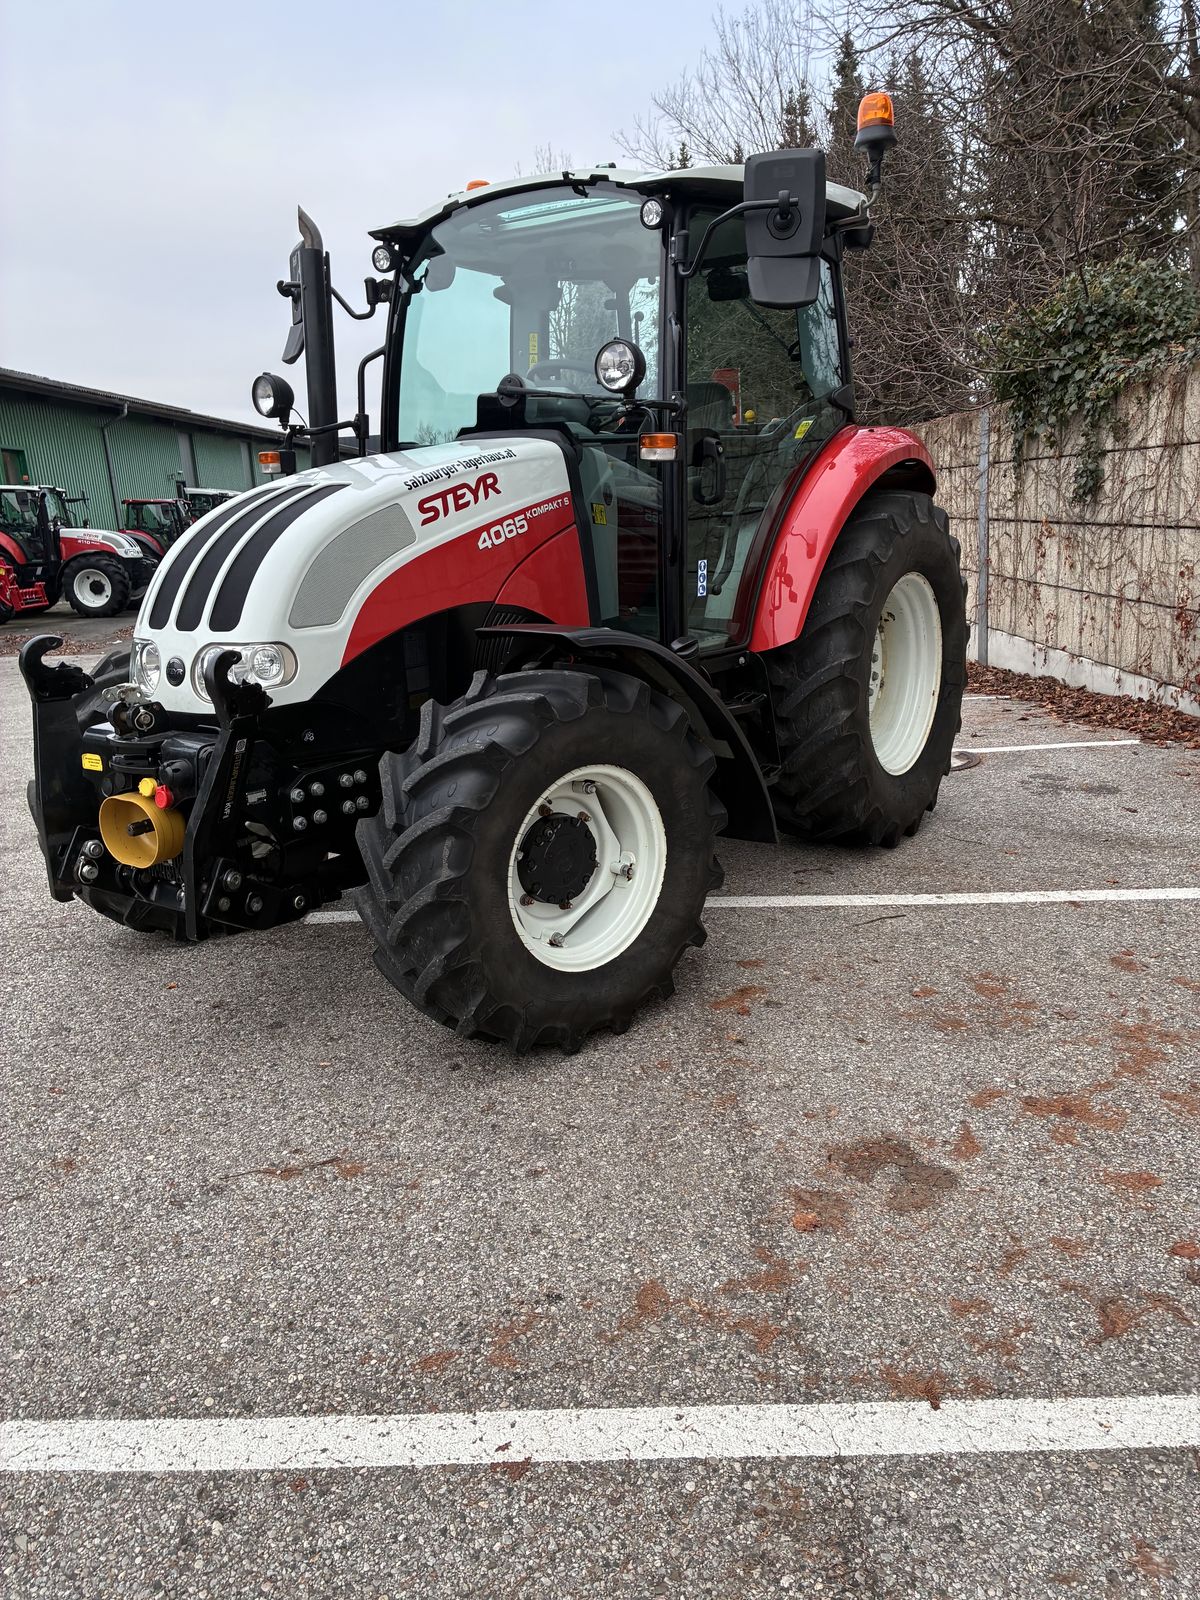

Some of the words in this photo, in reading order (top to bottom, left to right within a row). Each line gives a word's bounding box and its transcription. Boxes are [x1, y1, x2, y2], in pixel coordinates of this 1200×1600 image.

[403, 449, 517, 490] salzburger-lagerhaus.at
[418, 472, 502, 526] STEYR
[478, 515, 528, 550] 4065
[526, 499, 563, 519] KOMPAKT
[564, 497, 570, 506] S
